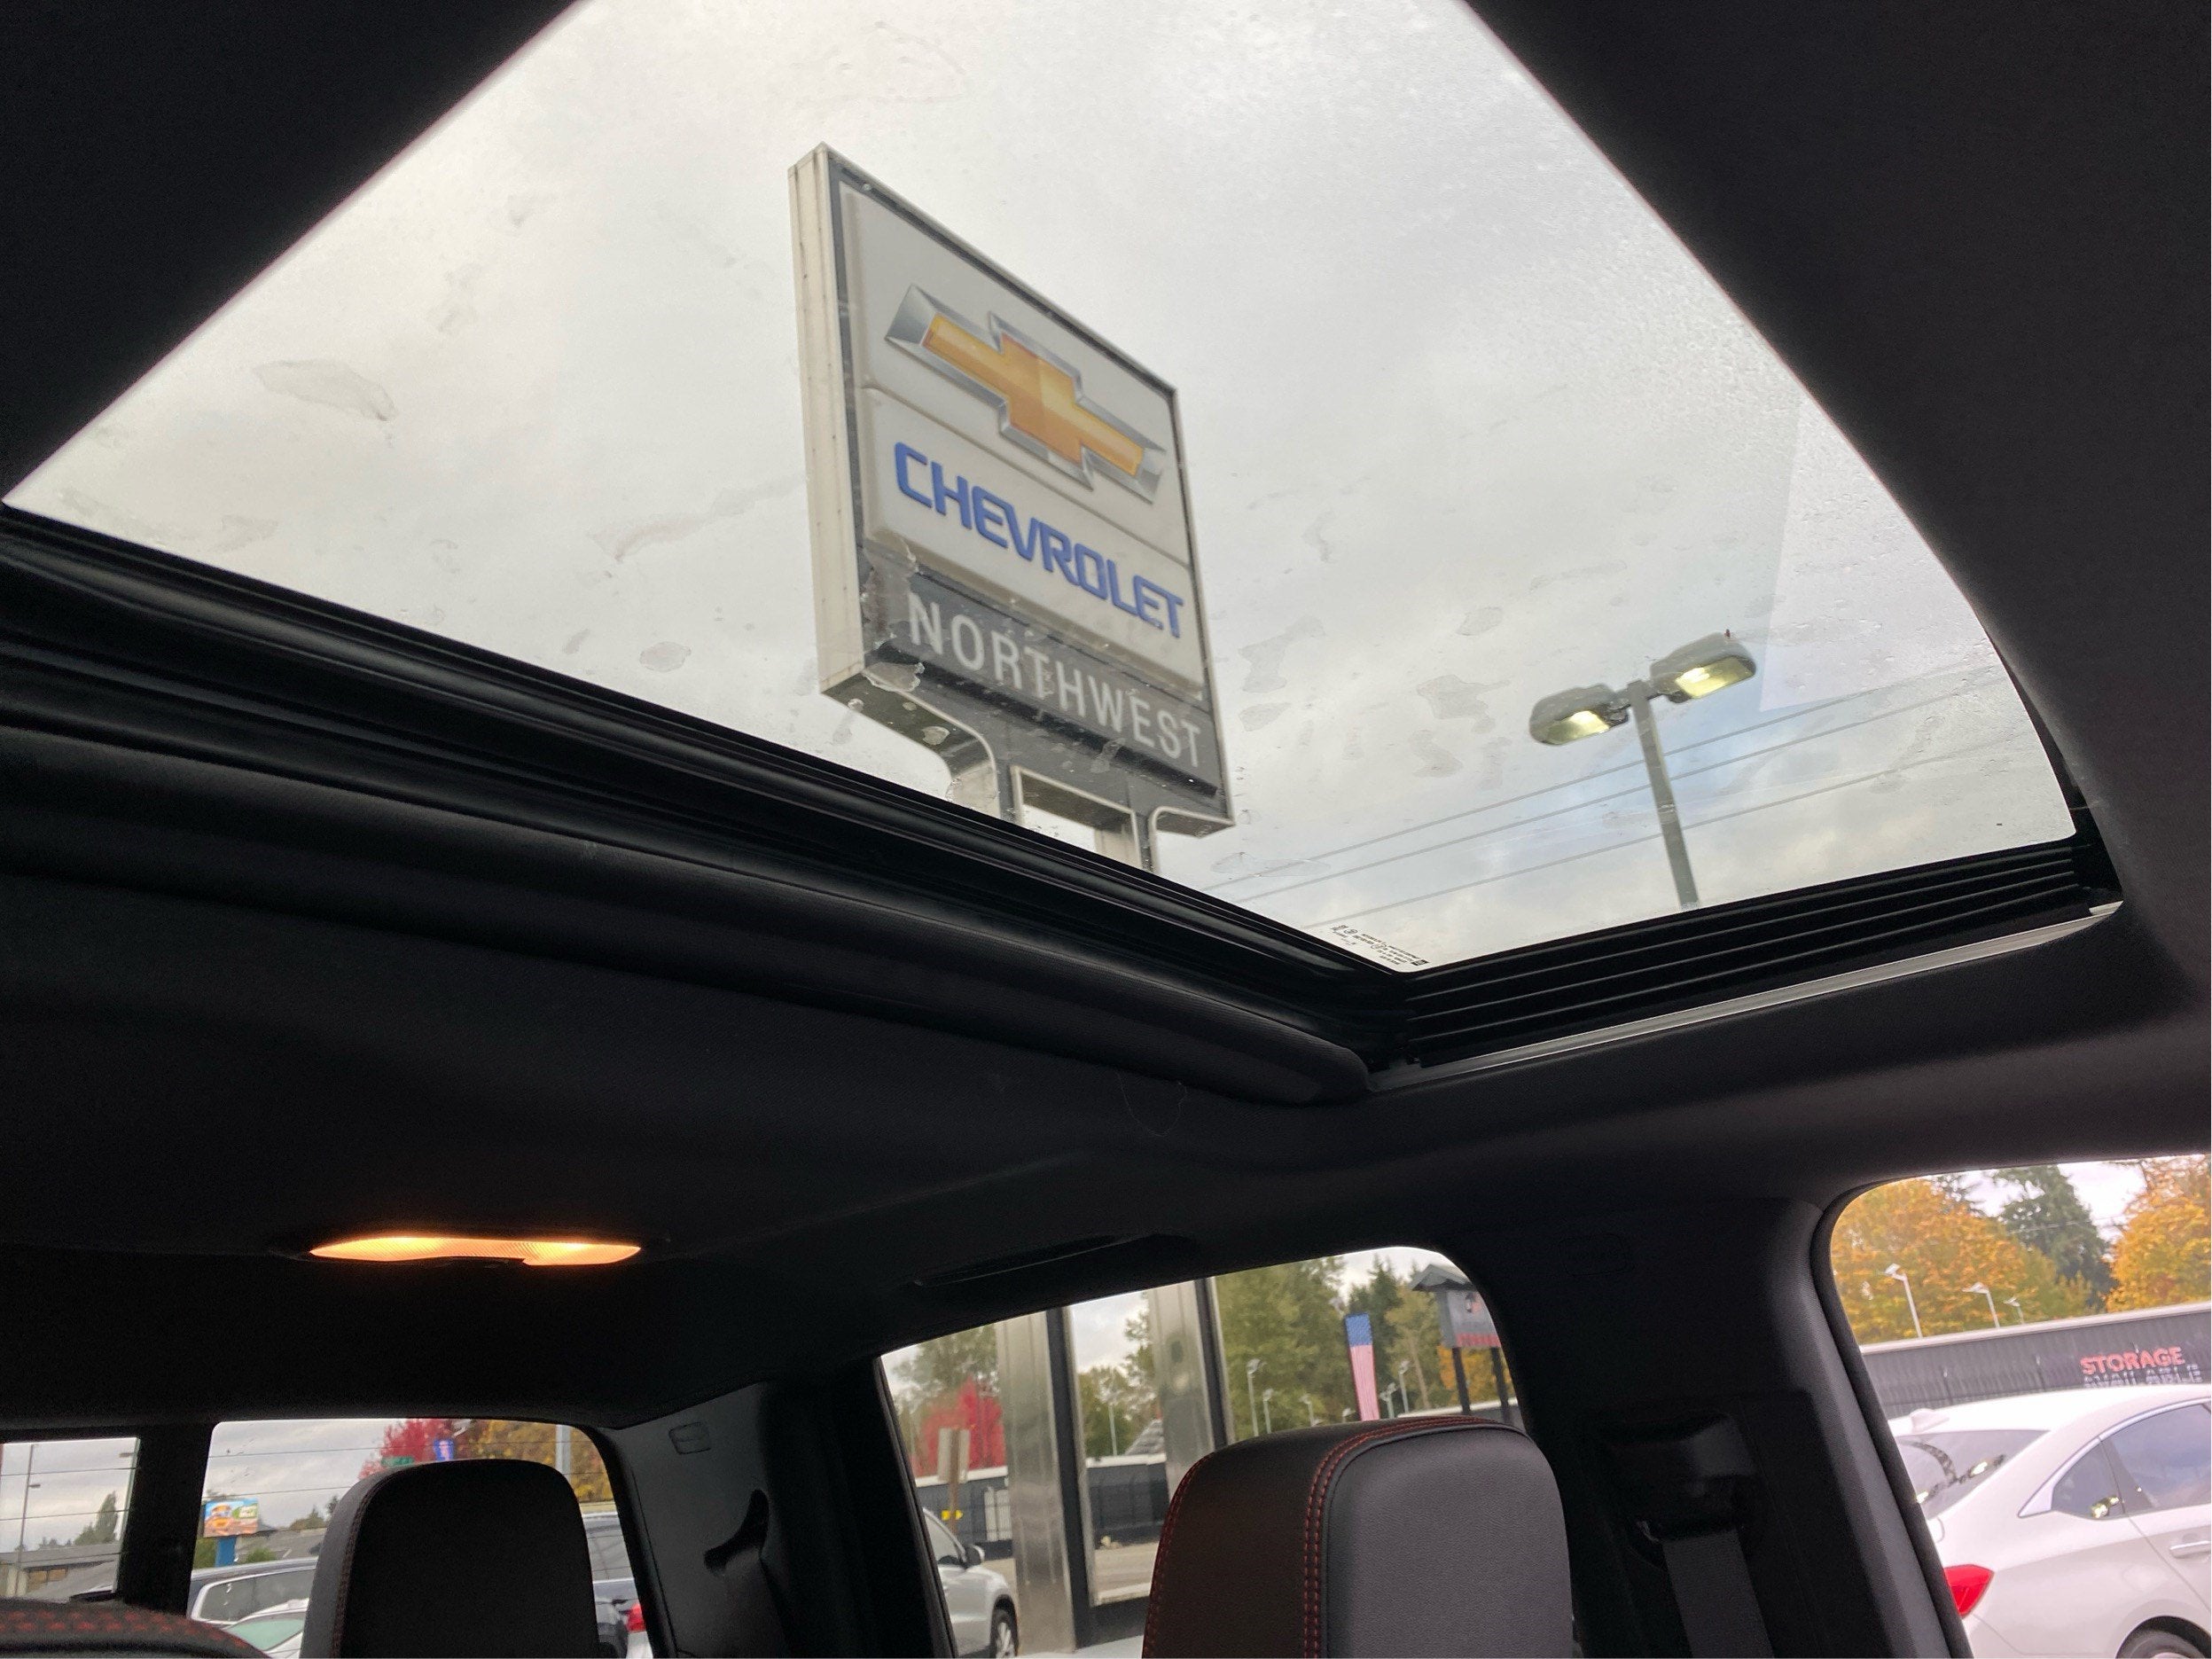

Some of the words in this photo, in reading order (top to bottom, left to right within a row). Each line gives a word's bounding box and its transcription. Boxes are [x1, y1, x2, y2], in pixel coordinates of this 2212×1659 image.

[894, 442, 1184, 638] CHEVROLET
[908, 591, 1202, 768] NORTHWEST
[2080, 1346, 2185, 1375] STORAGE
